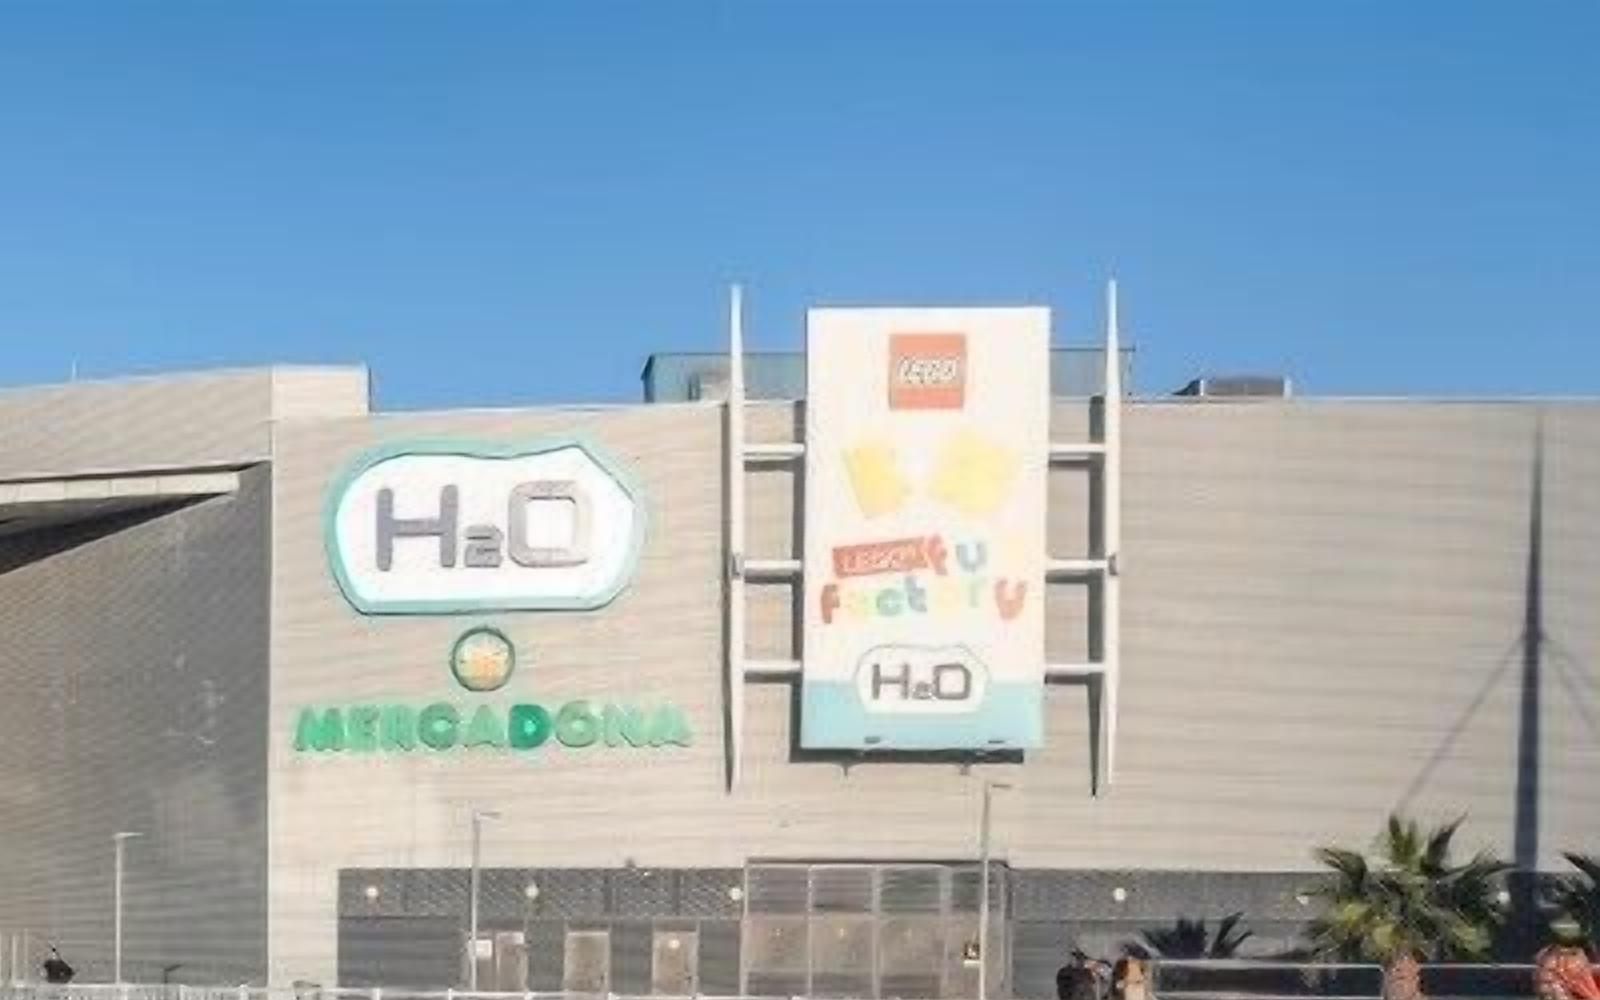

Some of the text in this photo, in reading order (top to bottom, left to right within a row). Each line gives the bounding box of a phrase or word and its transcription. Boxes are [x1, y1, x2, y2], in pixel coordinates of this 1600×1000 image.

[375, 479, 593, 573] H2O
[870, 662, 973, 702] H2O
[295, 701, 694, 752] MERCADONA
